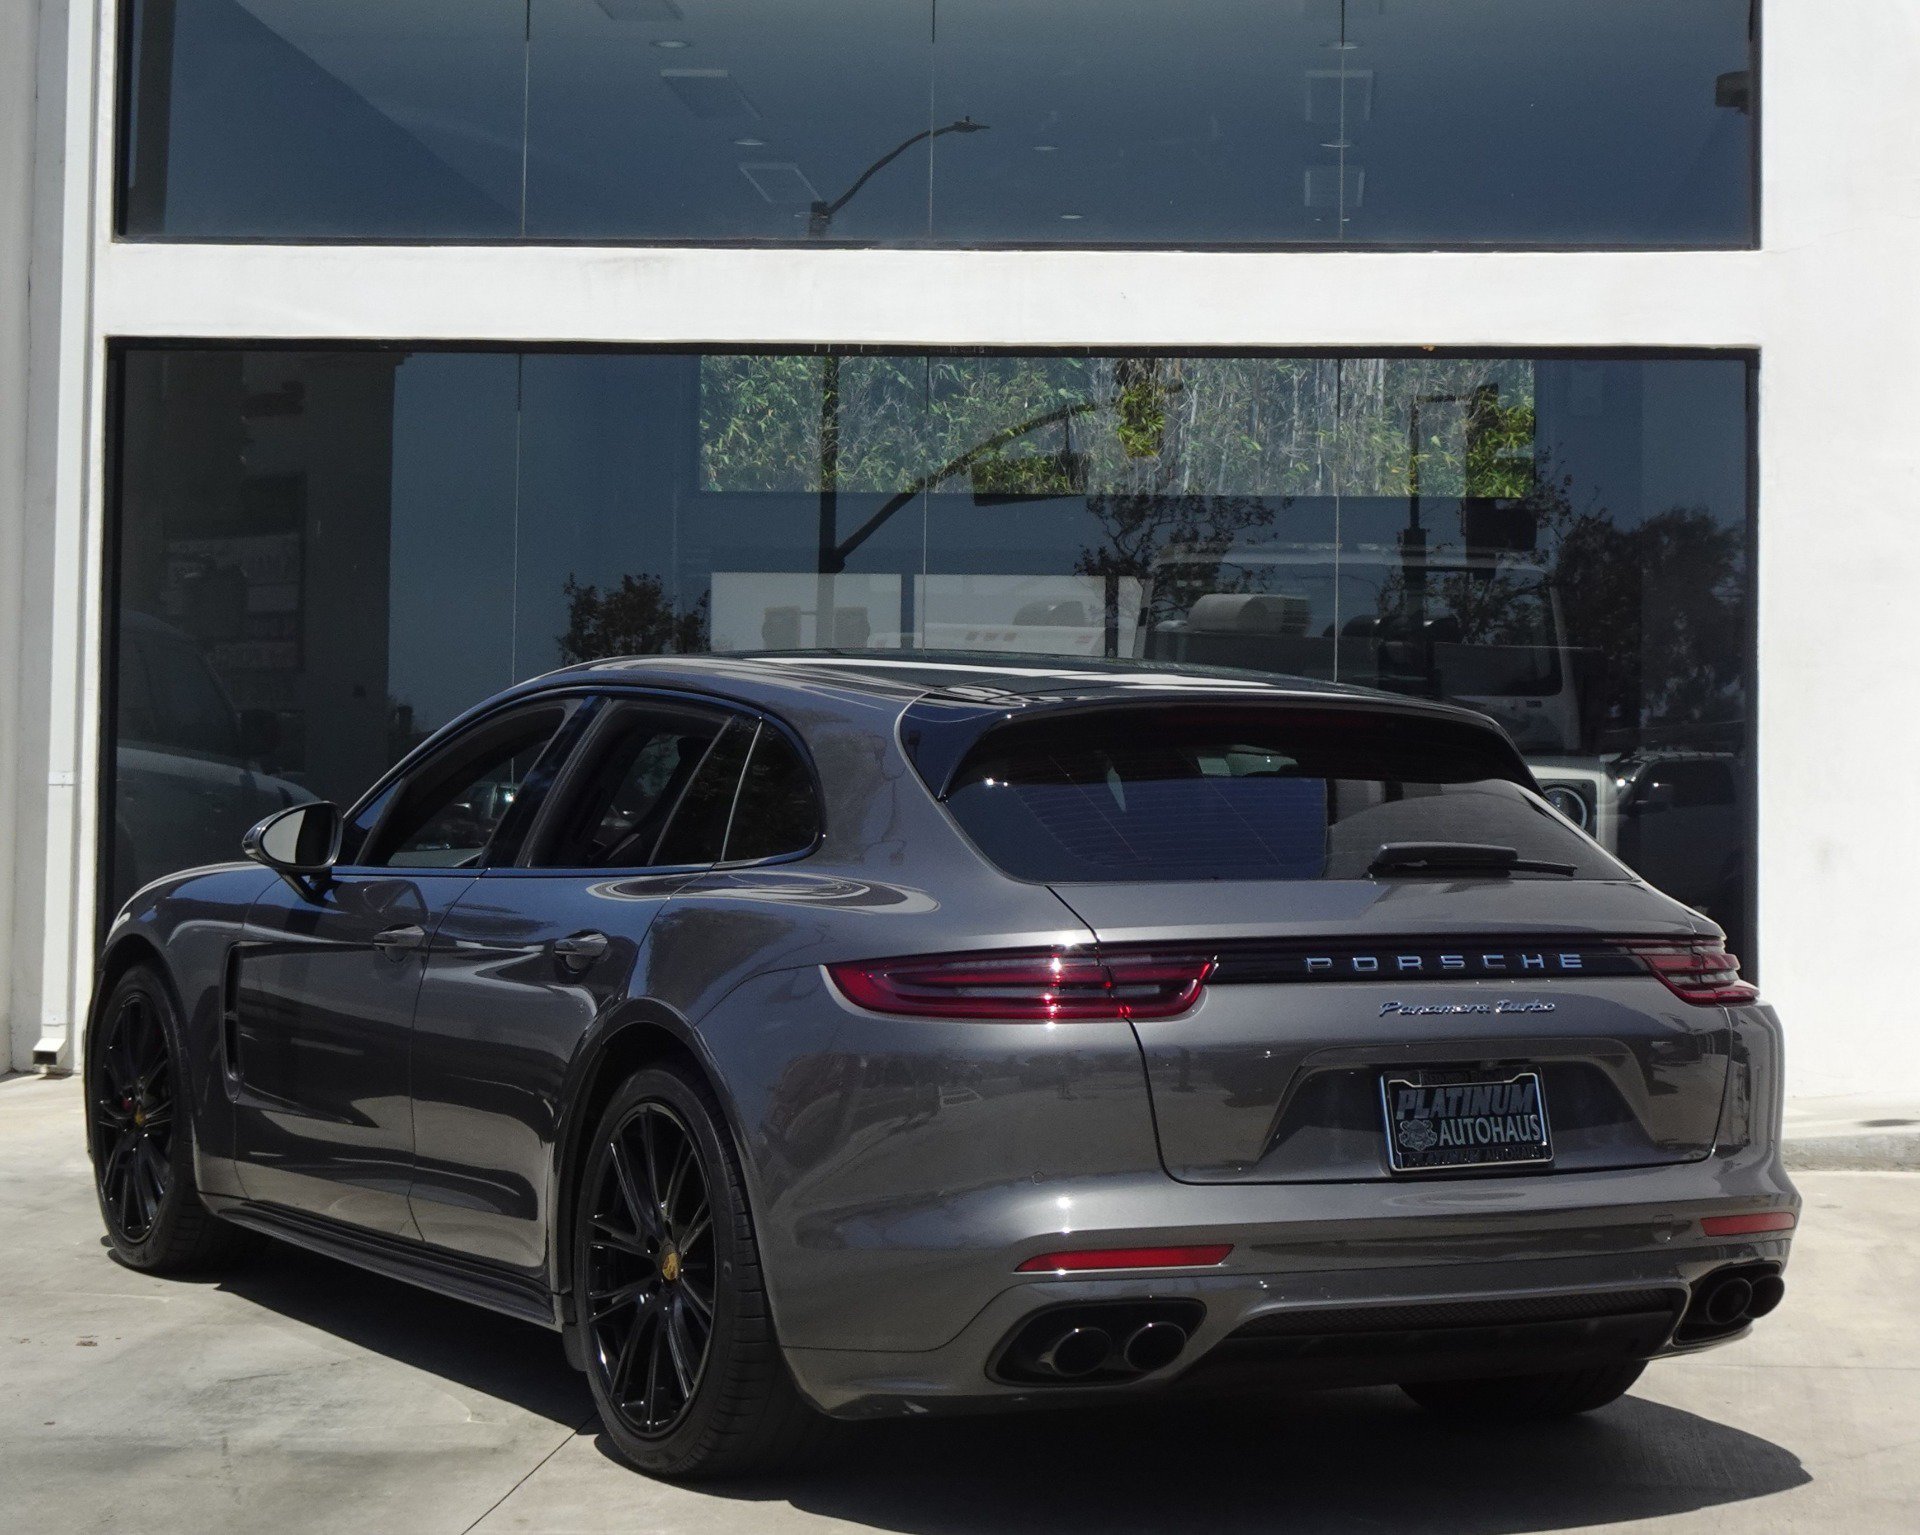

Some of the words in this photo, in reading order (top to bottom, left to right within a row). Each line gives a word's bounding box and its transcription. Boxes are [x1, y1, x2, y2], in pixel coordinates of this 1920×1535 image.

[1305, 952, 1583, 972] PORSCHE
[1379, 1001, 1490, 1017] Panamera
[1495, 998, 1555, 1014] Turbo
[1396, 1083, 1536, 1121] PLATINUM
[1438, 1114, 1542, 1147] AUTOHAUS
